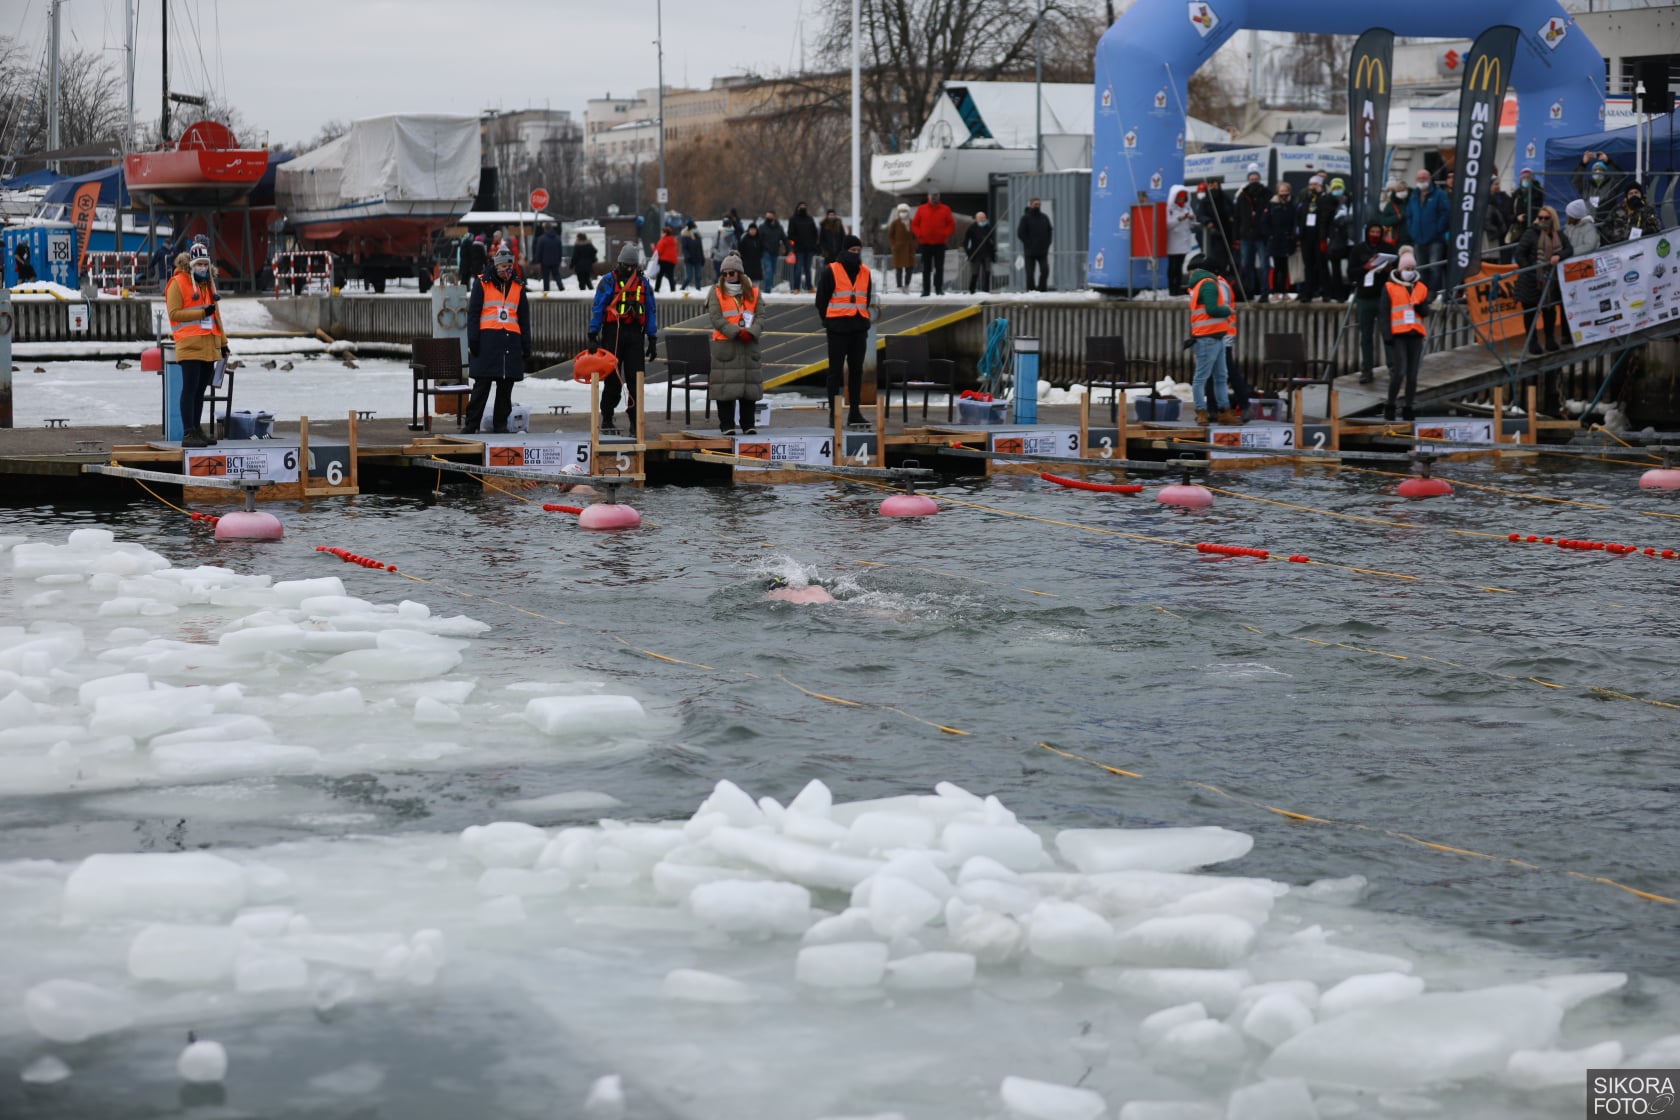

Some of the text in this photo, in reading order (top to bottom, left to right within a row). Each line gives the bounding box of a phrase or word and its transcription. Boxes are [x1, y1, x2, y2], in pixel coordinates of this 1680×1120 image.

[1456, 101, 1489, 267] McDonald's
[1283, 430, 1293, 446] 2
[1483, 425, 1491, 439] 1
[1511, 430, 1520, 444] 1
[772, 444, 787, 456] BCT
[819, 440, 831, 458] 4
[1068, 434, 1079, 451] 3
[1100, 437, 1113, 459] 3
[1313, 432, 1326, 451] 2
[226, 457, 244, 468] BCT
[283, 451, 296, 469] 6
[524, 448, 541, 459] BCT
[576, 445, 588, 463] 5
[615, 451, 631, 472] 5
[855, 442, 870, 465] 4
[326, 460, 343, 486] 6
